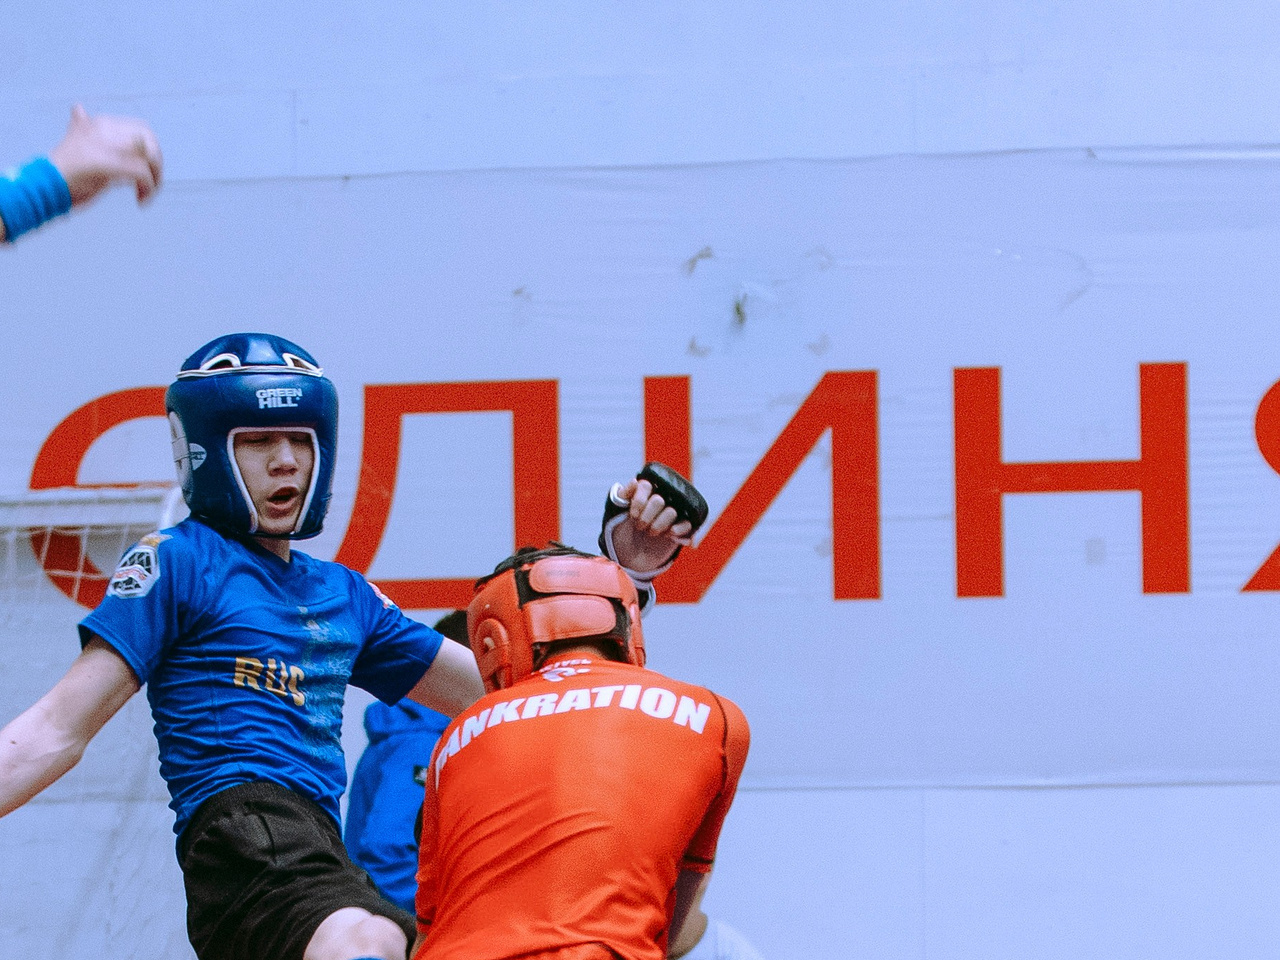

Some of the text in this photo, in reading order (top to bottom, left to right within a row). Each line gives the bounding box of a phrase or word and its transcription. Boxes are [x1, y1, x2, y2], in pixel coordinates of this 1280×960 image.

[256, 388, 303, 399] GREEN
[258, 396, 299, 409] HILL
[435, 684, 711, 792] ANKRATION
